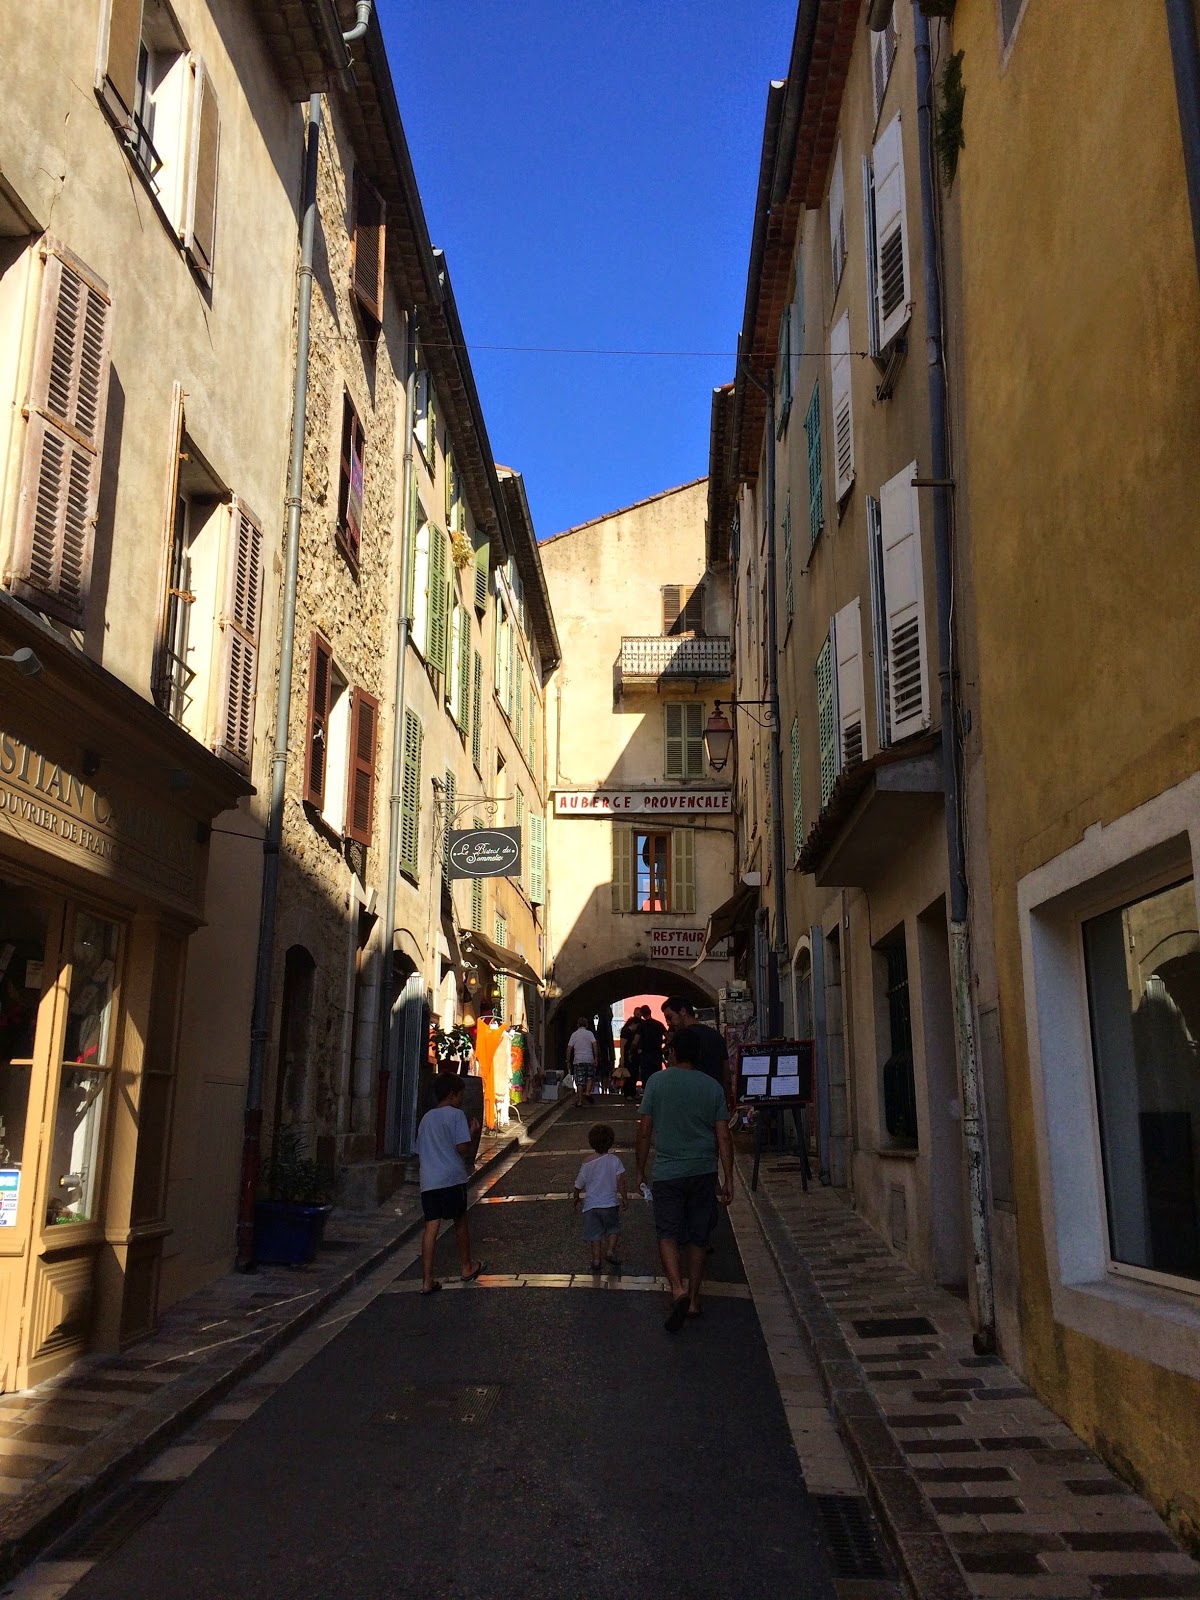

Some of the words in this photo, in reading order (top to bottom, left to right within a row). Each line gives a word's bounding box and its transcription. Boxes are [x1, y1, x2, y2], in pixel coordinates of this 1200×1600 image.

[559, 796, 632, 808] AUBERGE
[61, 818, 78, 843] DE
[653, 931, 704, 942] RESTAUR
[653, 945, 693, 956] HOTEL
